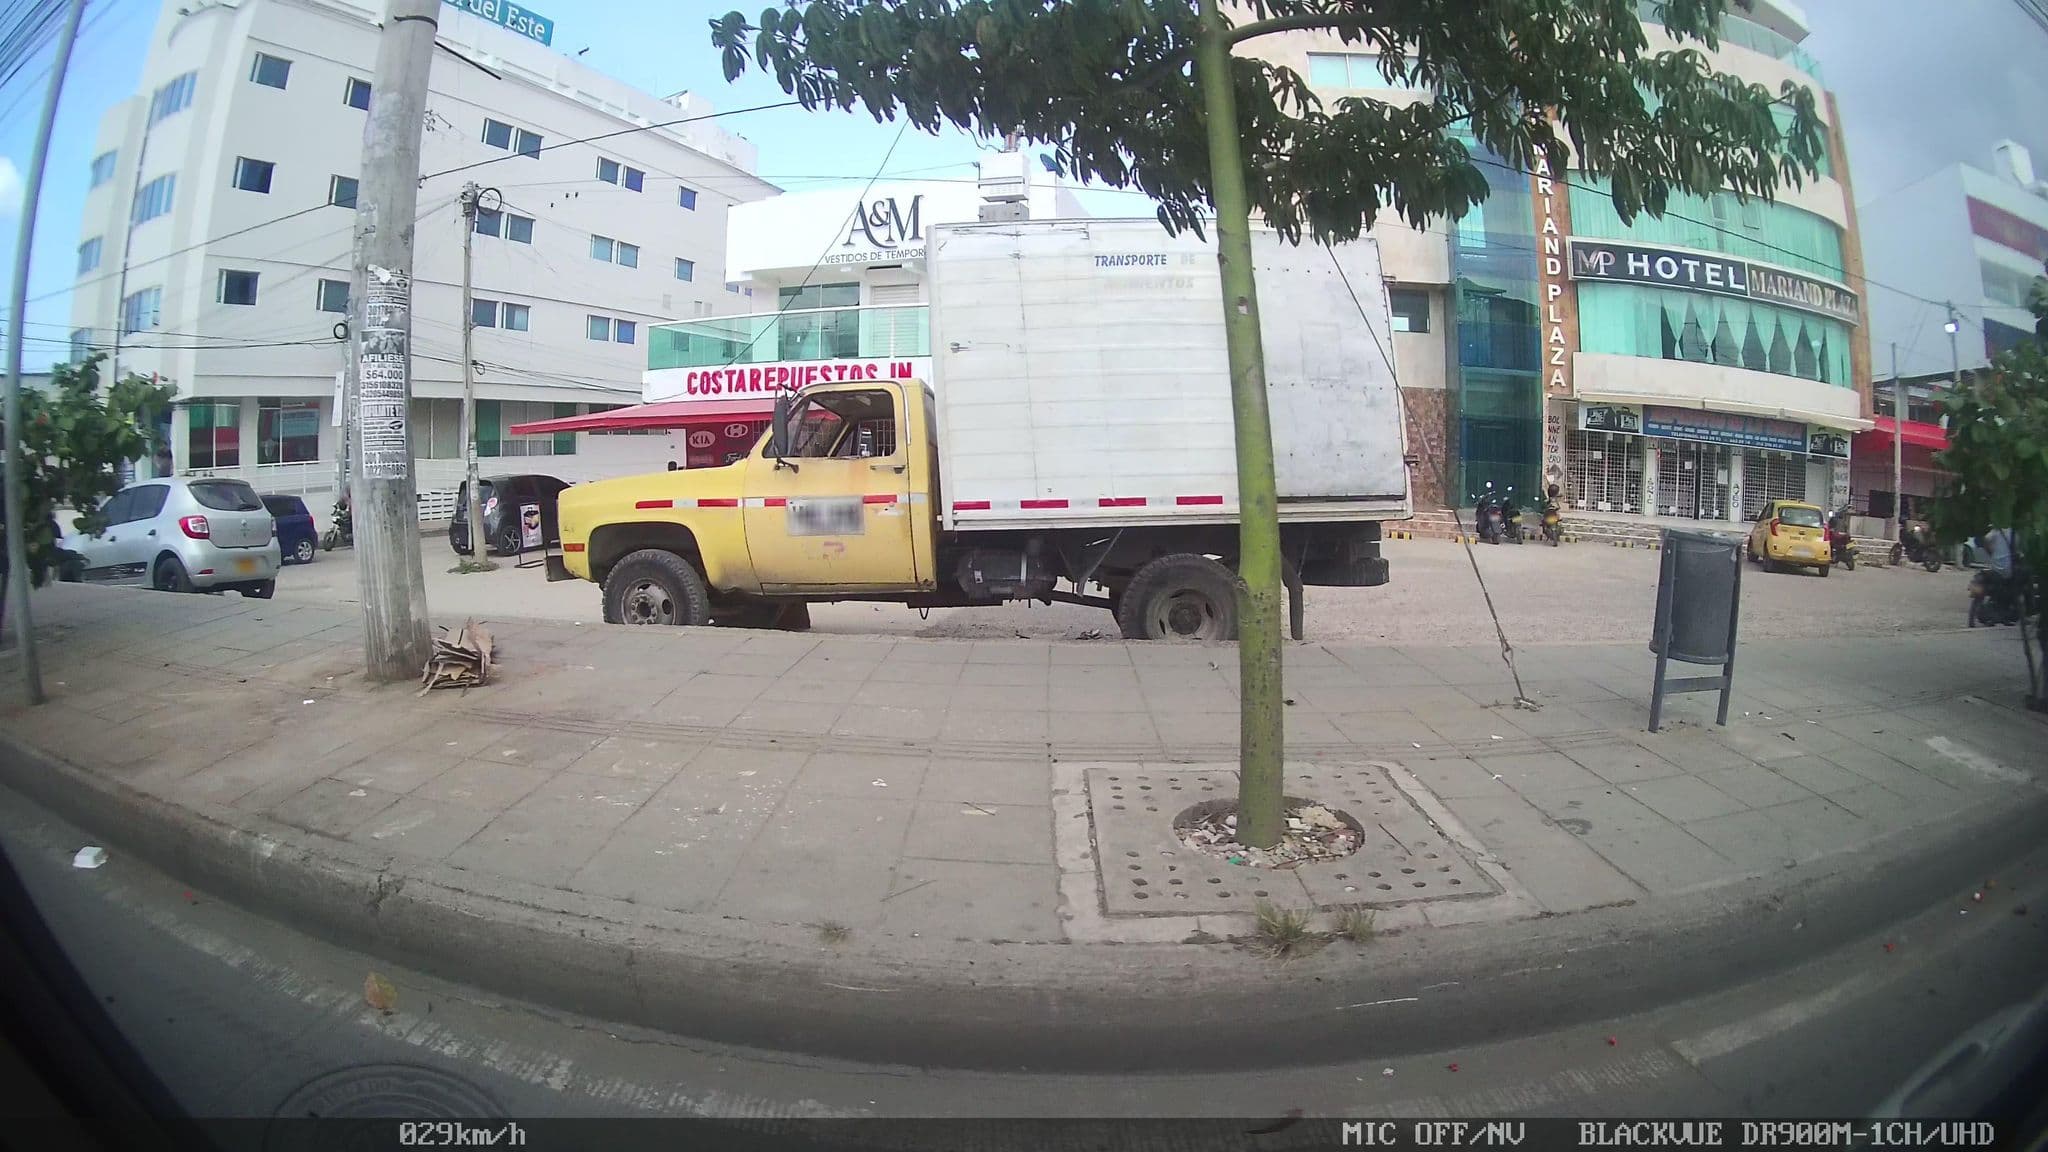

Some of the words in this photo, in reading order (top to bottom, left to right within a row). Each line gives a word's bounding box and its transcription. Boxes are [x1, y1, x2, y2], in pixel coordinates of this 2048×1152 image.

[505, 6, 545, 40] Este
[842, 194, 926, 249] A&M
[825, 252, 867, 264] VESTIDOS
[870, 251, 882, 261] DE
[885, 248, 927, 260] TEMPOR
[1094, 254, 1168, 268] TRANSPORTE
[1627, 252, 1746, 291] HOTEL
[1751, 269, 1823, 307] MARIAND
[1824, 287, 1858, 320] PLAZA
[1547, 283, 1567, 388] PLAZA
[687, 362, 879, 395] COSTAREPUESTOS
[691, 435, 711, 445] KIA
